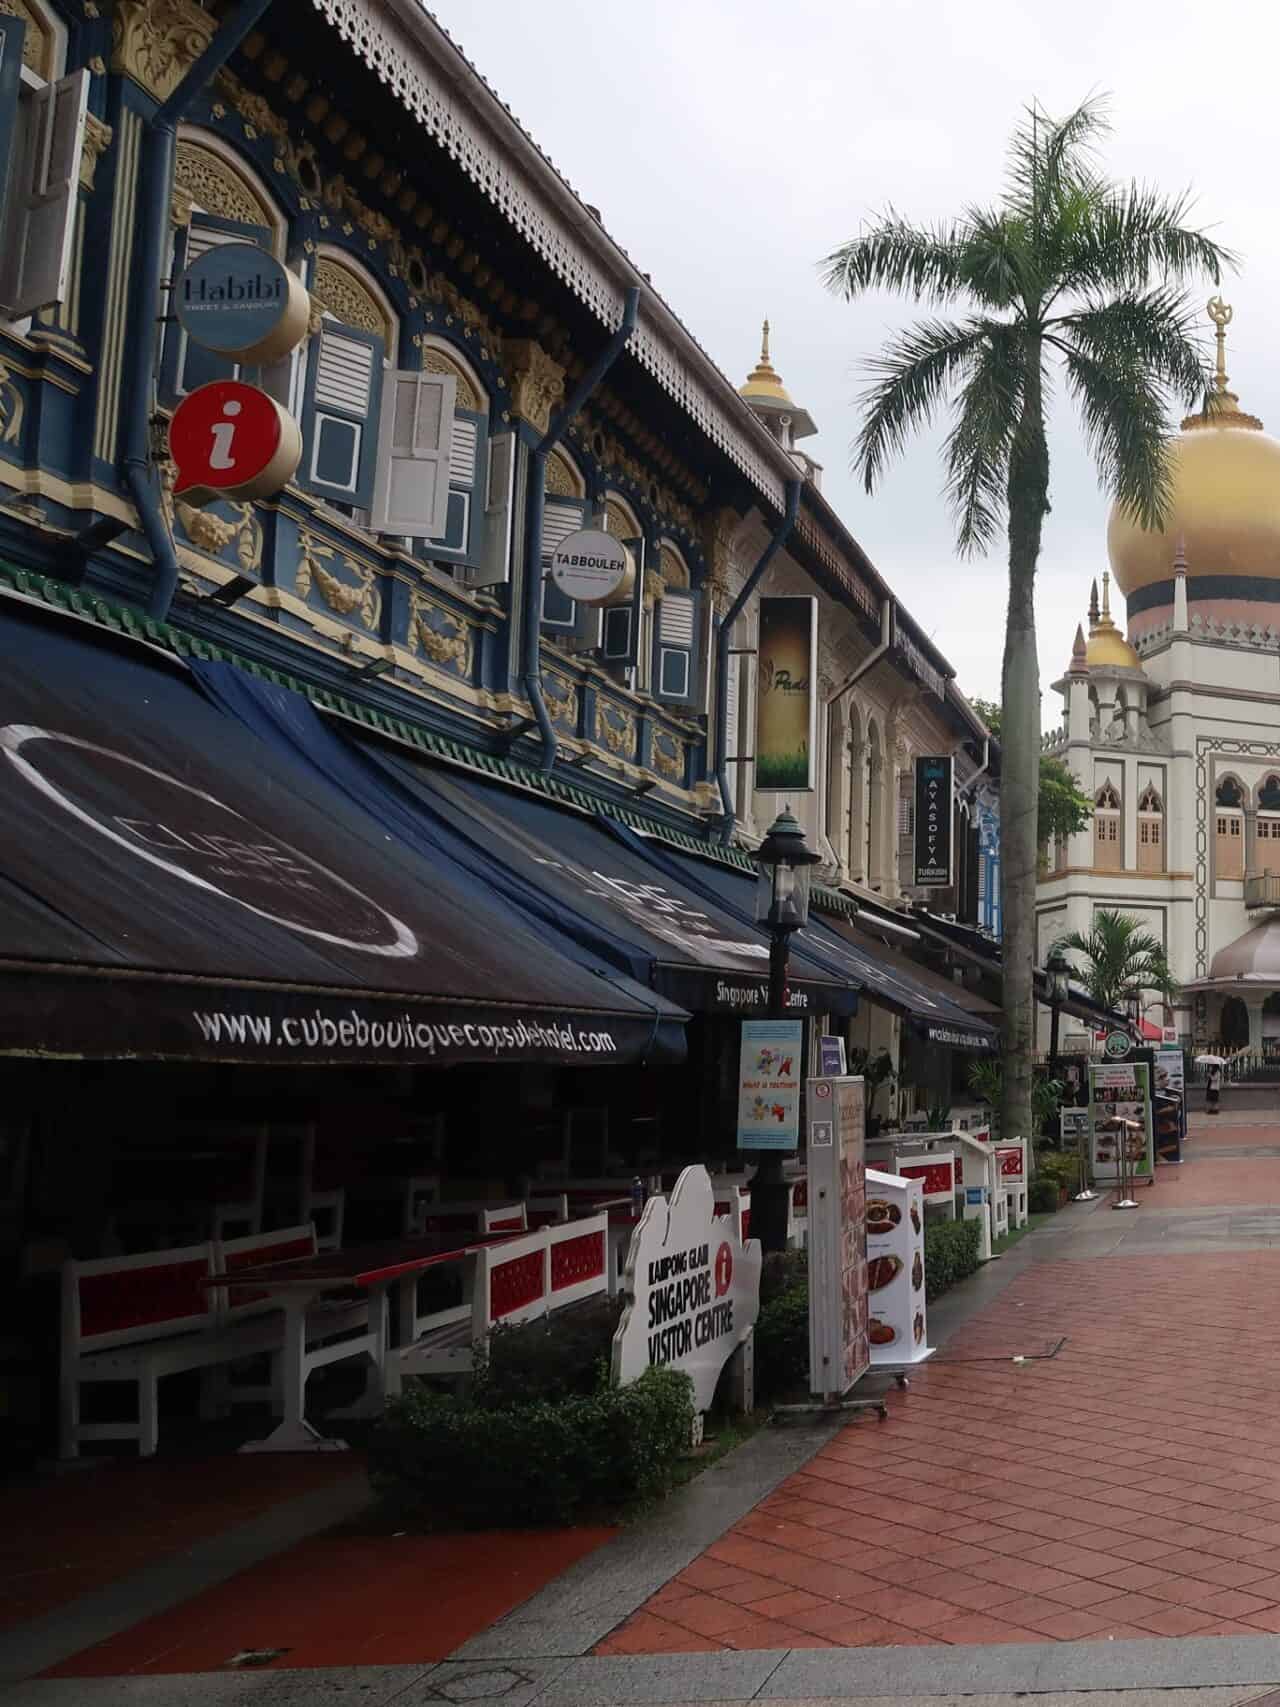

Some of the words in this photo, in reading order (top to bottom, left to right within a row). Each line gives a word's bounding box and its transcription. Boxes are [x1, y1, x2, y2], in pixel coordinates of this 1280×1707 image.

[183, 273, 282, 301] Habibi
[556, 553, 625, 571] TABBOULEH
[927, 779, 938, 865] AYASOFYA
[717, 980, 761, 1006] Singapore
[648, 1251, 687, 1286] KAMPONG
[688, 1243, 709, 1270] GLAM
[648, 1269, 711, 1329] SINGAPORE
[648, 1318, 692, 1366] VISITOR
[695, 1299, 734, 1348] CENTRE
